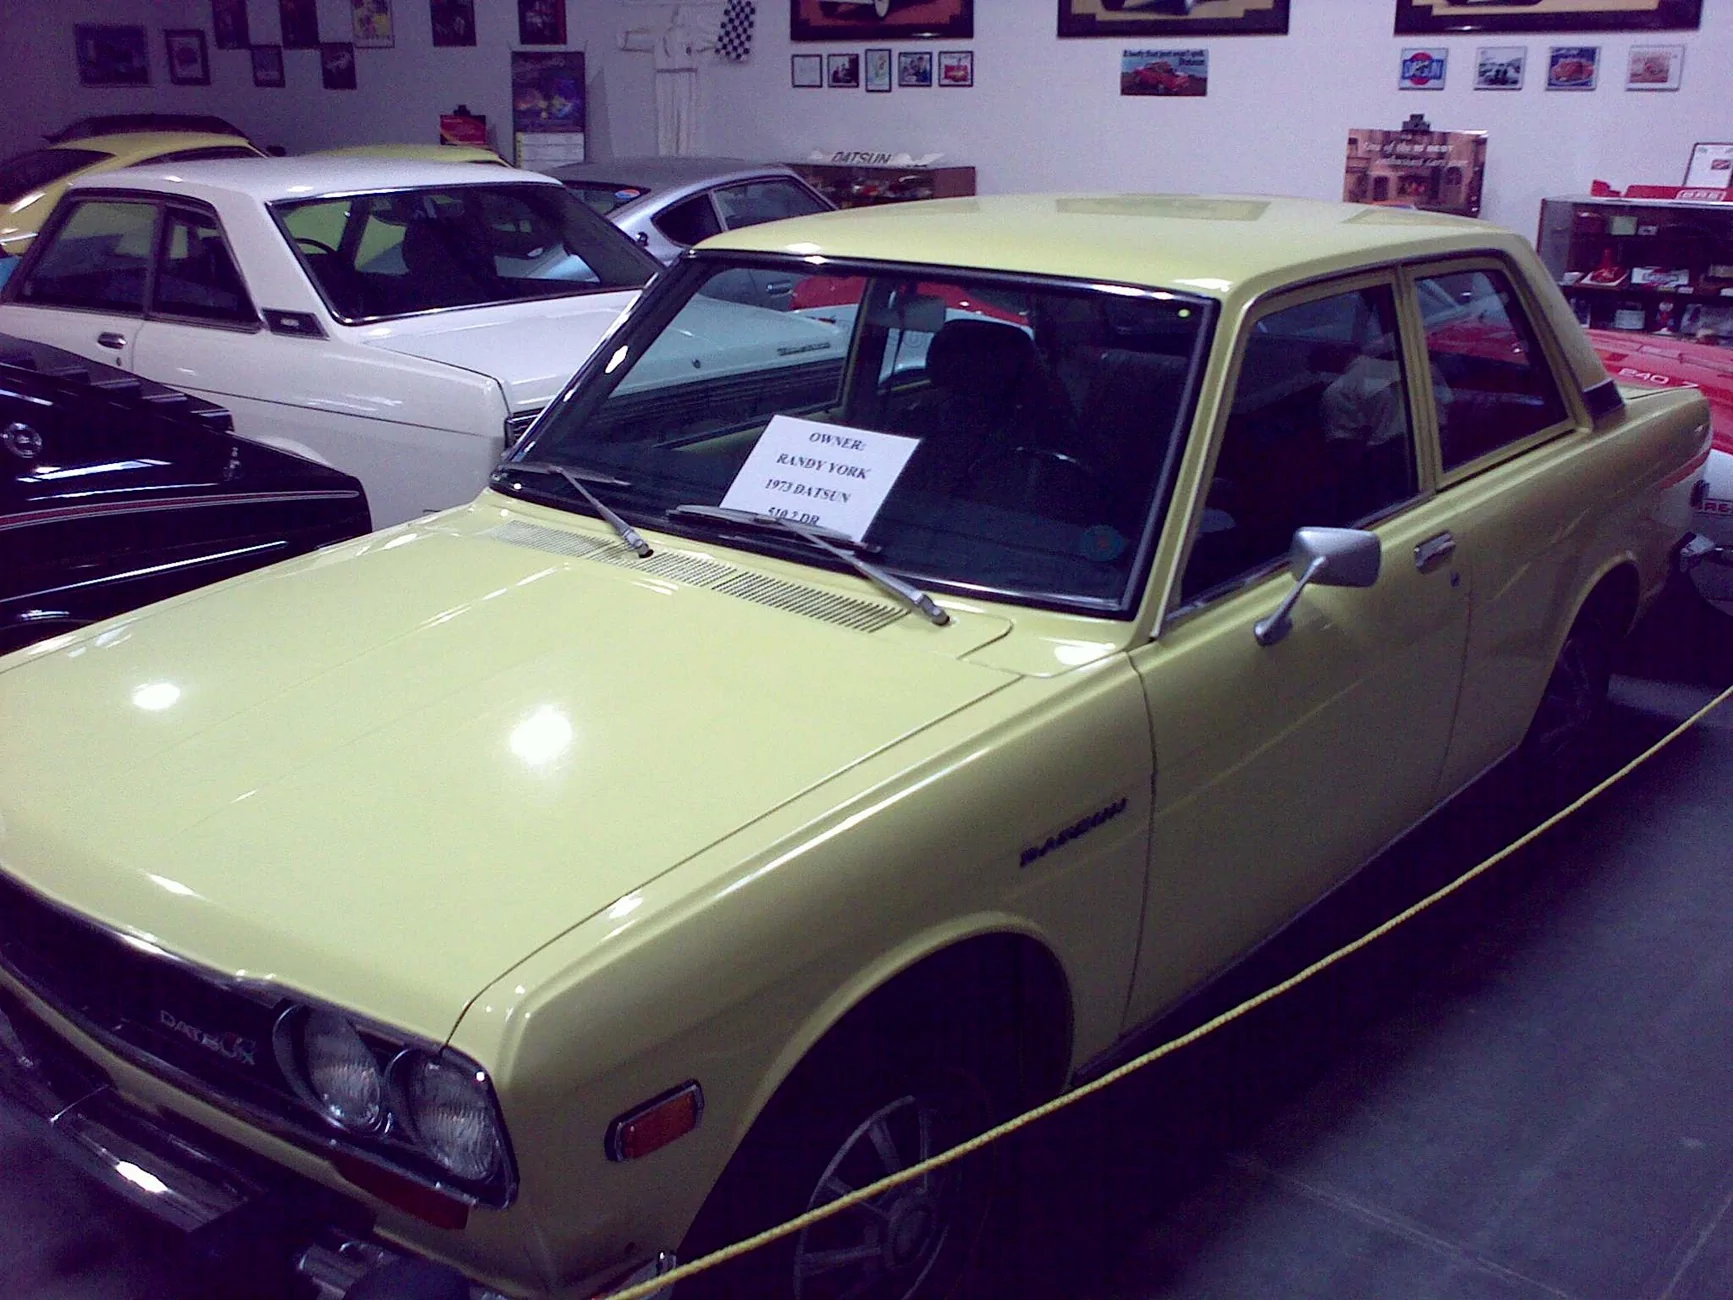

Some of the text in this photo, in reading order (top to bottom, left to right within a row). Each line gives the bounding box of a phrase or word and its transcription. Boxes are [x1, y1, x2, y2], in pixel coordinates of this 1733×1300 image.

[832, 151, 892, 164] DATSUN
[1618, 367, 1670, 385] 240
[809, 432, 867, 452] OWNER:
[776, 453, 871, 480] RANDY YORK
[766, 478, 851, 503] 1973 DATSUN
